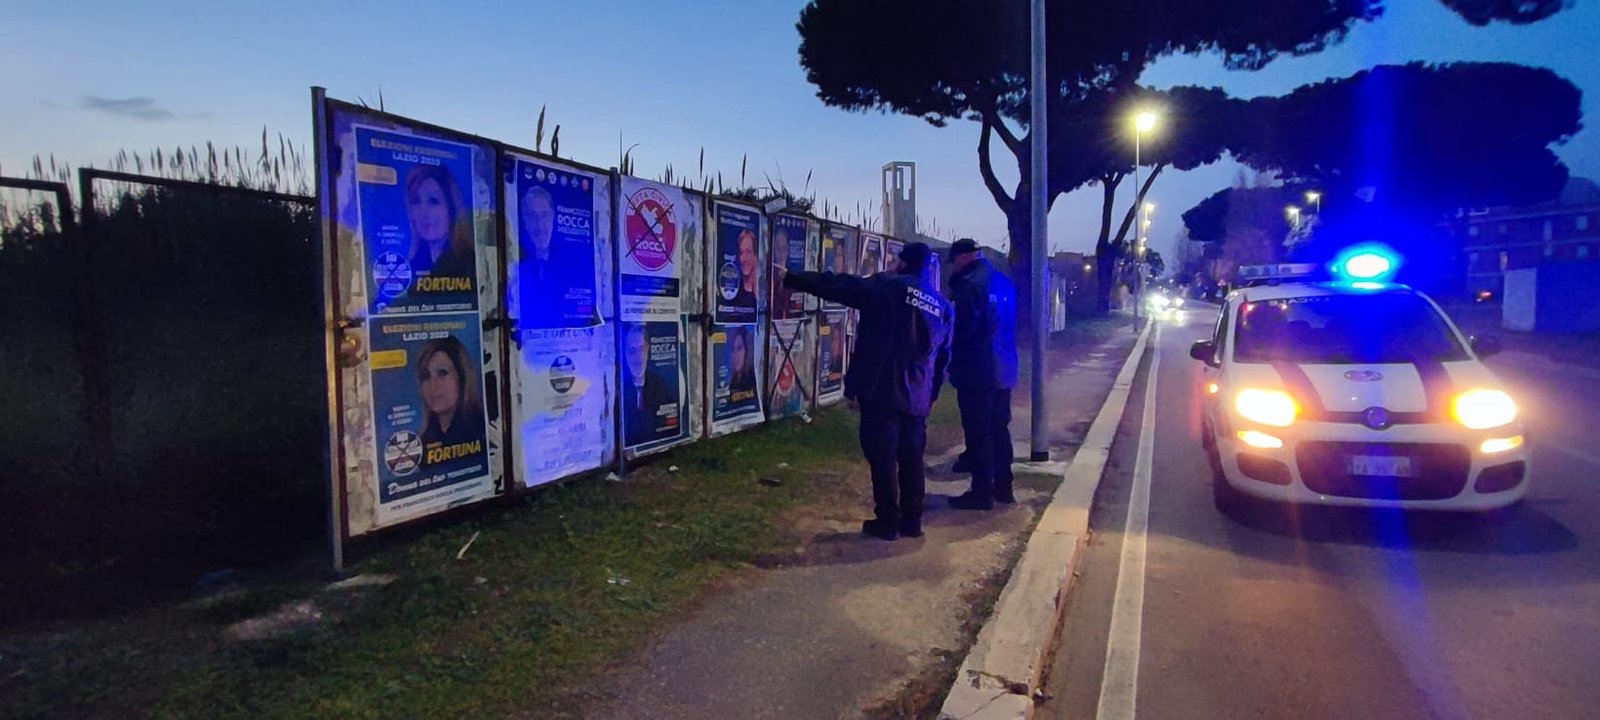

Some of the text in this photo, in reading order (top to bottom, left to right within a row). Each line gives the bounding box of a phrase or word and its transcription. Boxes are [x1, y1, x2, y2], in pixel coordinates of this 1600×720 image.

[392, 151, 419, 163] LAZIO
[557, 214, 590, 228] ROCCA
[636, 239, 667, 252] ROCCA
[416, 277, 472, 292] FORTUNA
[907, 286, 941, 307] POLIZIA
[905, 296, 941, 317] LOCALE
[383, 321, 466, 334] ELEZIONI REGIONALI
[402, 332, 428, 342] LAZIO
[650, 344, 676, 353] ROCCA
[427, 440, 482, 465] FORTUNA
